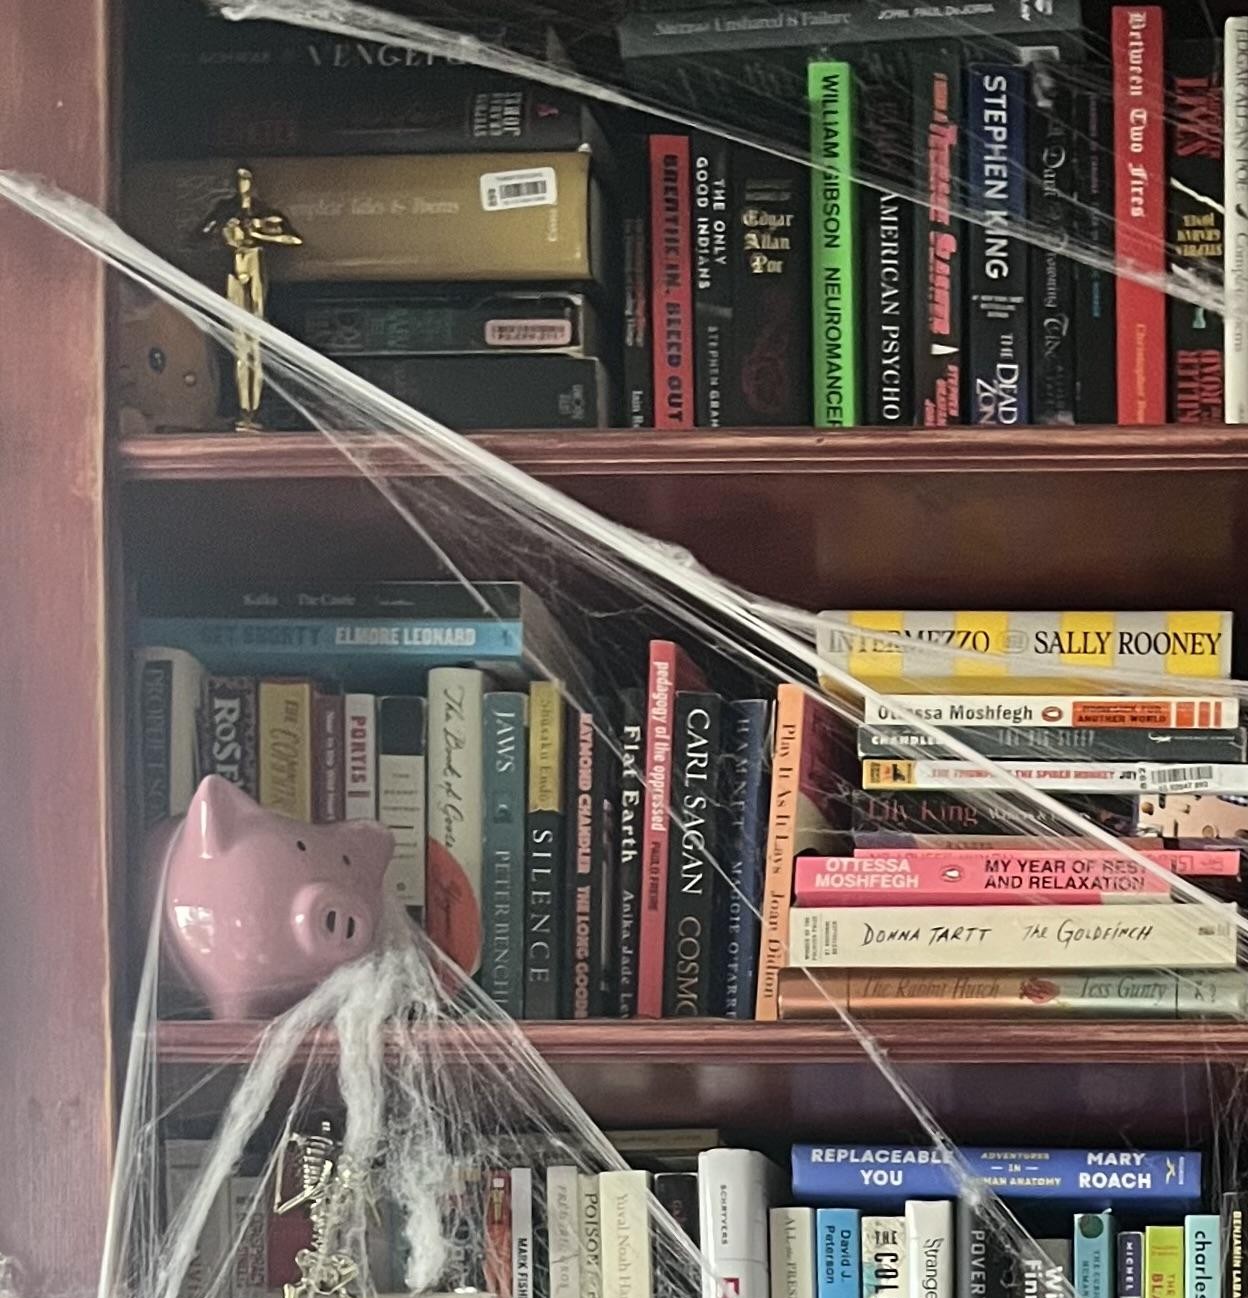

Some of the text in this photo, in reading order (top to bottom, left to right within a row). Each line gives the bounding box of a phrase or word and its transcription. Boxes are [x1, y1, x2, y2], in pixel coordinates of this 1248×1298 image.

[1127, 12, 1148, 218] Between Two Fires
[983, 75, 1006, 199] STEPHEN
[820, 74, 841, 248] WILLIAM GIBSON
[984, 210, 1009, 279] KING
[996, 364, 1019, 425] DEAD
[335, 627, 475, 646] ELMORE LEONARD
[1034, 630, 1222, 655] SALLY ROONEY
[495, 710, 516, 773] JAWS
[622, 725, 640, 864] Flat Earth
[682, 708, 710, 895] CARL SAGAN
[825, 858, 911, 873] OTTESSA
[985, 859, 1011, 874] MY
[1016, 859, 1067, 874] YEAR
[1071, 859, 1097, 874] OF
[815, 873, 920, 889] MOSHFEGH
[985, 874, 1146, 891] AND RELAXATION
[530, 828, 550, 984] SILENCE
[862, 924, 921, 946] DONNA
[928, 926, 992, 944] TARTT
[1087, 1151, 1146, 1166] MARY
[861, 1170, 903, 1186] YOU
[1079, 1171, 1151, 1190] ROACH
[874, 1231, 898, 1245] THE
